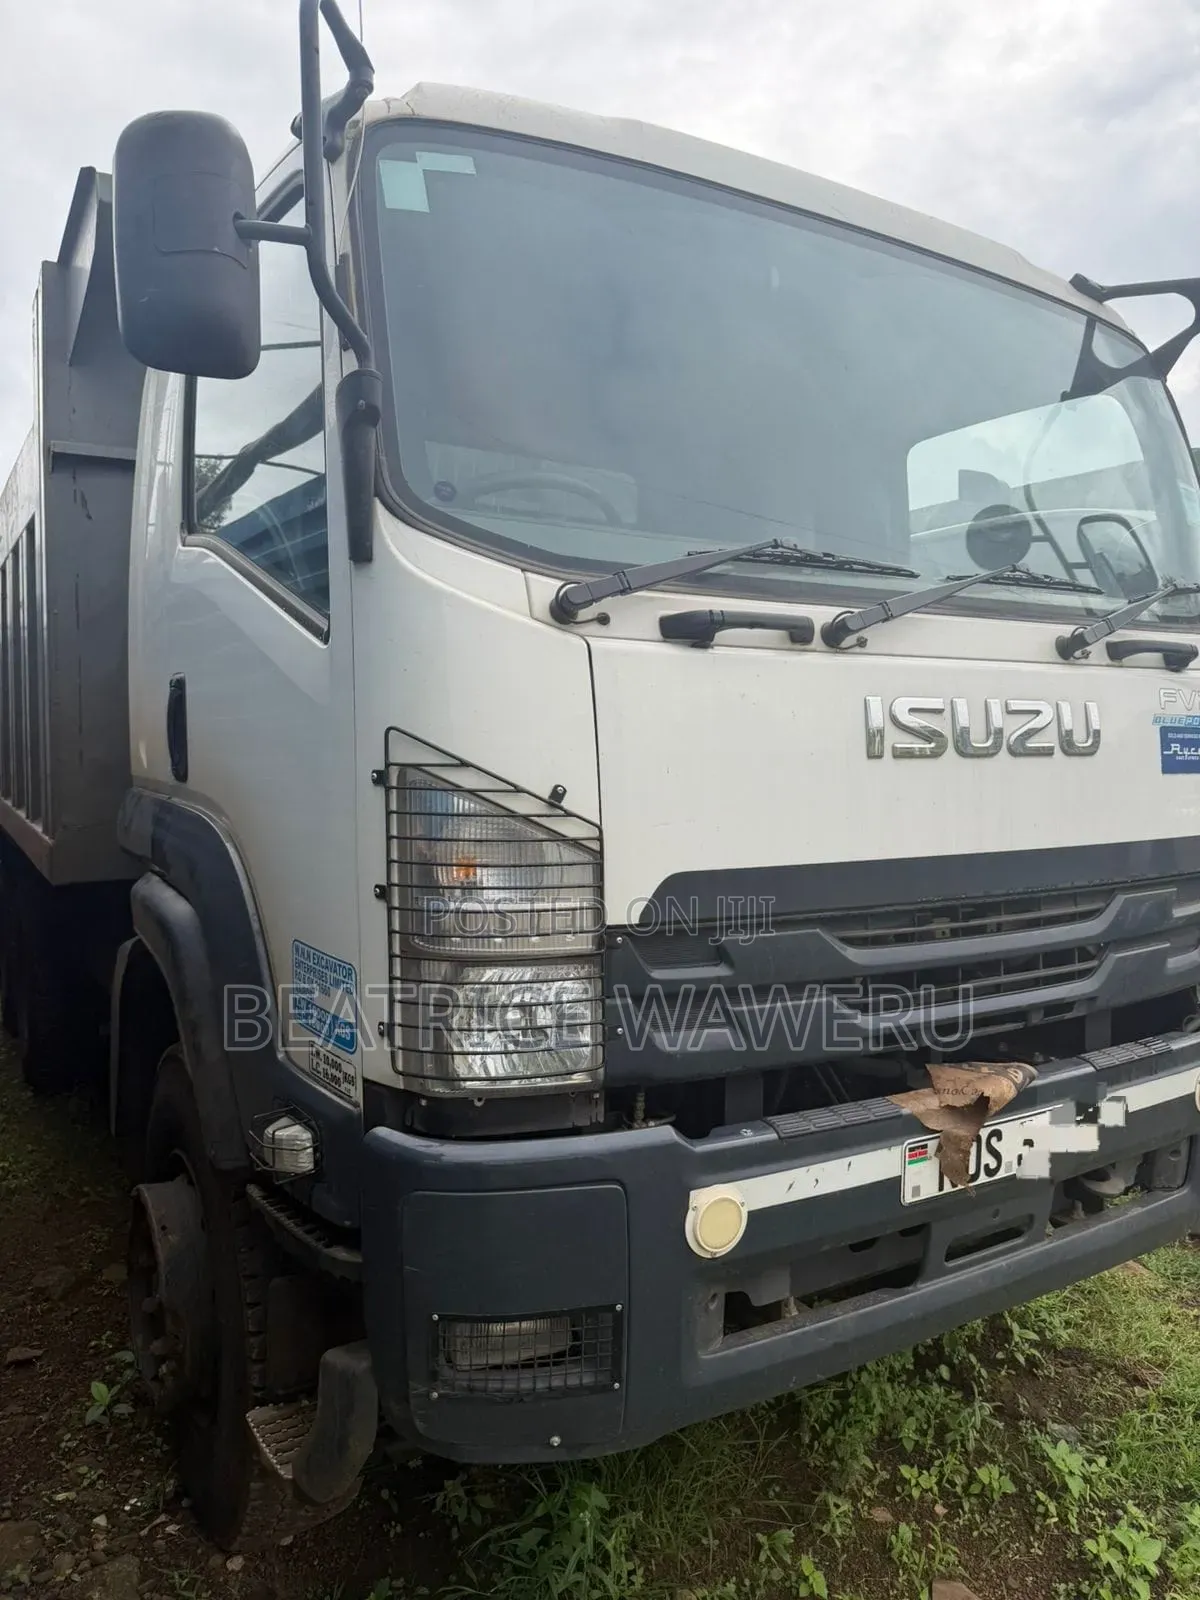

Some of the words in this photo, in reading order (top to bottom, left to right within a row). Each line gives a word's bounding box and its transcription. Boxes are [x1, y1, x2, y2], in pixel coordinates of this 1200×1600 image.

[1159, 688, 1200, 711] FV
[864, 695, 1101, 759] ISUZU
[294, 957, 329, 986] ENTERPRISES
[312, 952, 353, 982] EXCAVATOR
